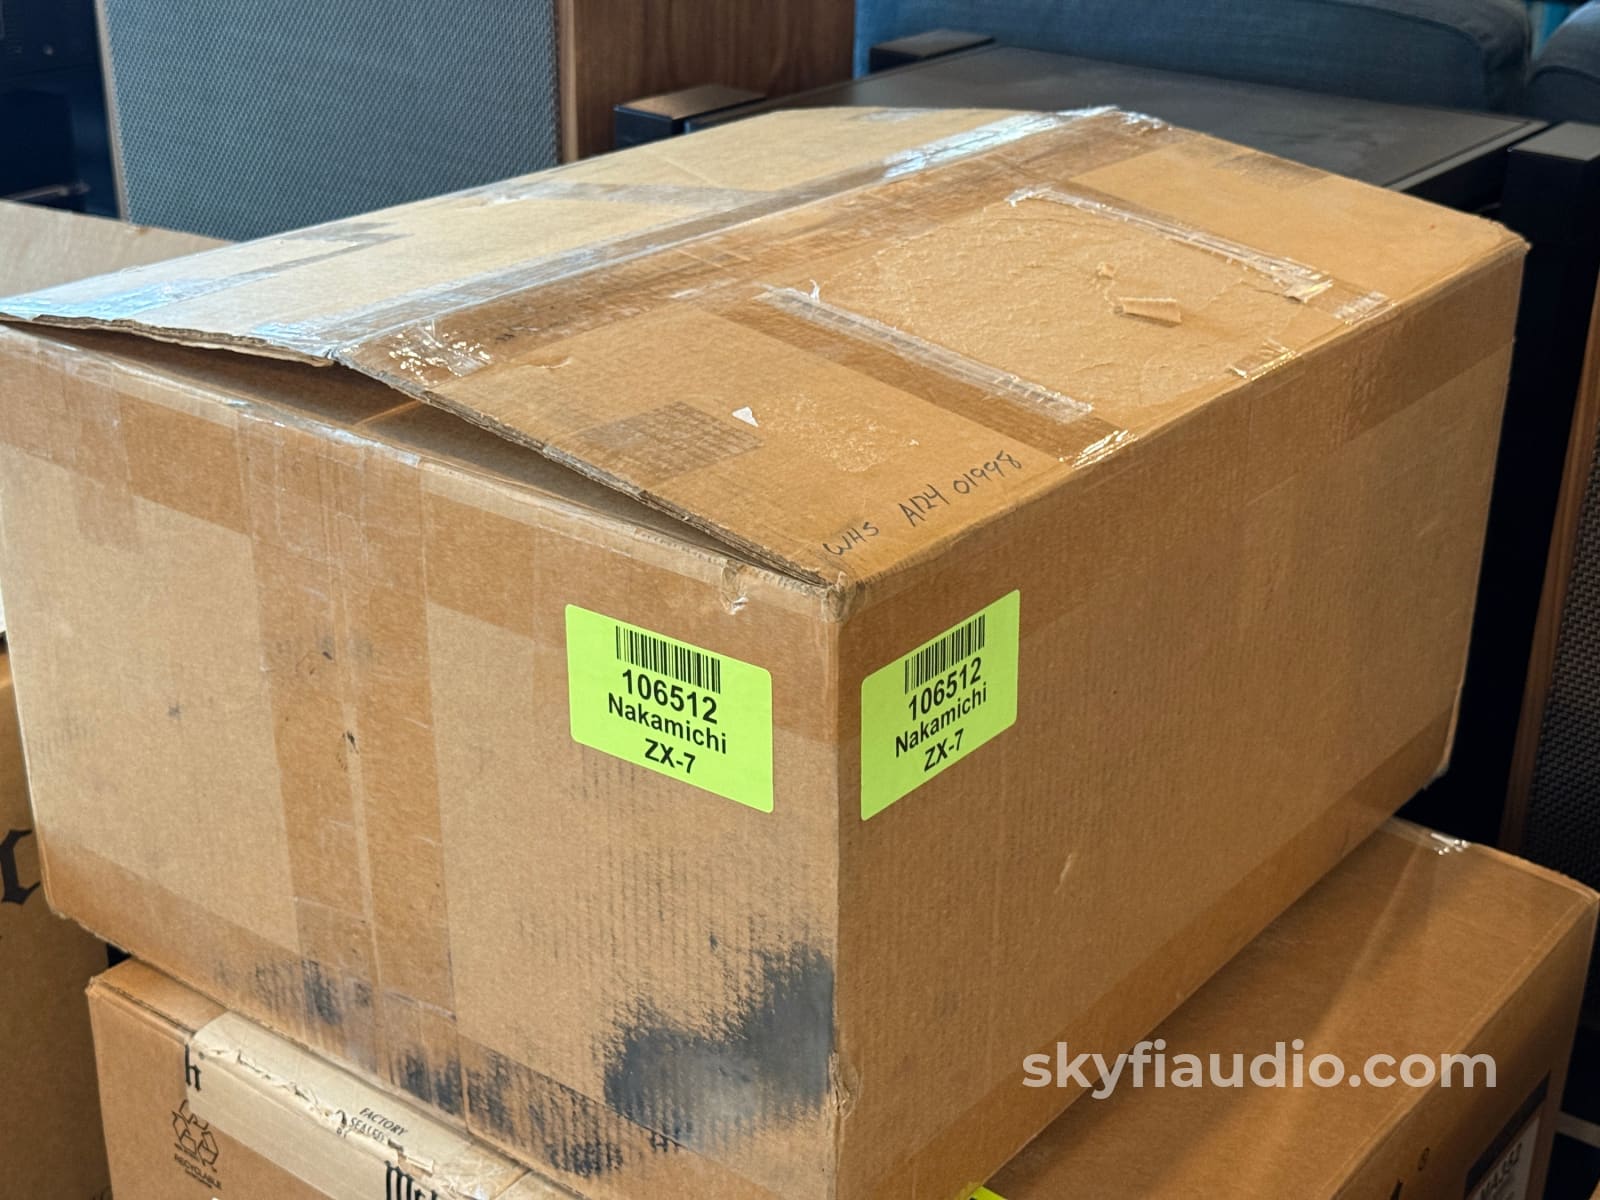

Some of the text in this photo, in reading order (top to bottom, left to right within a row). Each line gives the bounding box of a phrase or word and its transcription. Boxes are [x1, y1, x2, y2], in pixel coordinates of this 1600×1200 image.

[822, 521, 880, 556] WHS
[621, 668, 718, 724] 106512
[908, 656, 982, 721] 106512
[607, 693, 727, 755] Nakamichi
[895, 681, 988, 758] Nakamichi
[645, 738, 697, 774] ZX-7
[924, 728, 965, 772] ZX-7
[350, 1117, 385, 1143] SEALED
[359, 1107, 408, 1136] FACTORY
